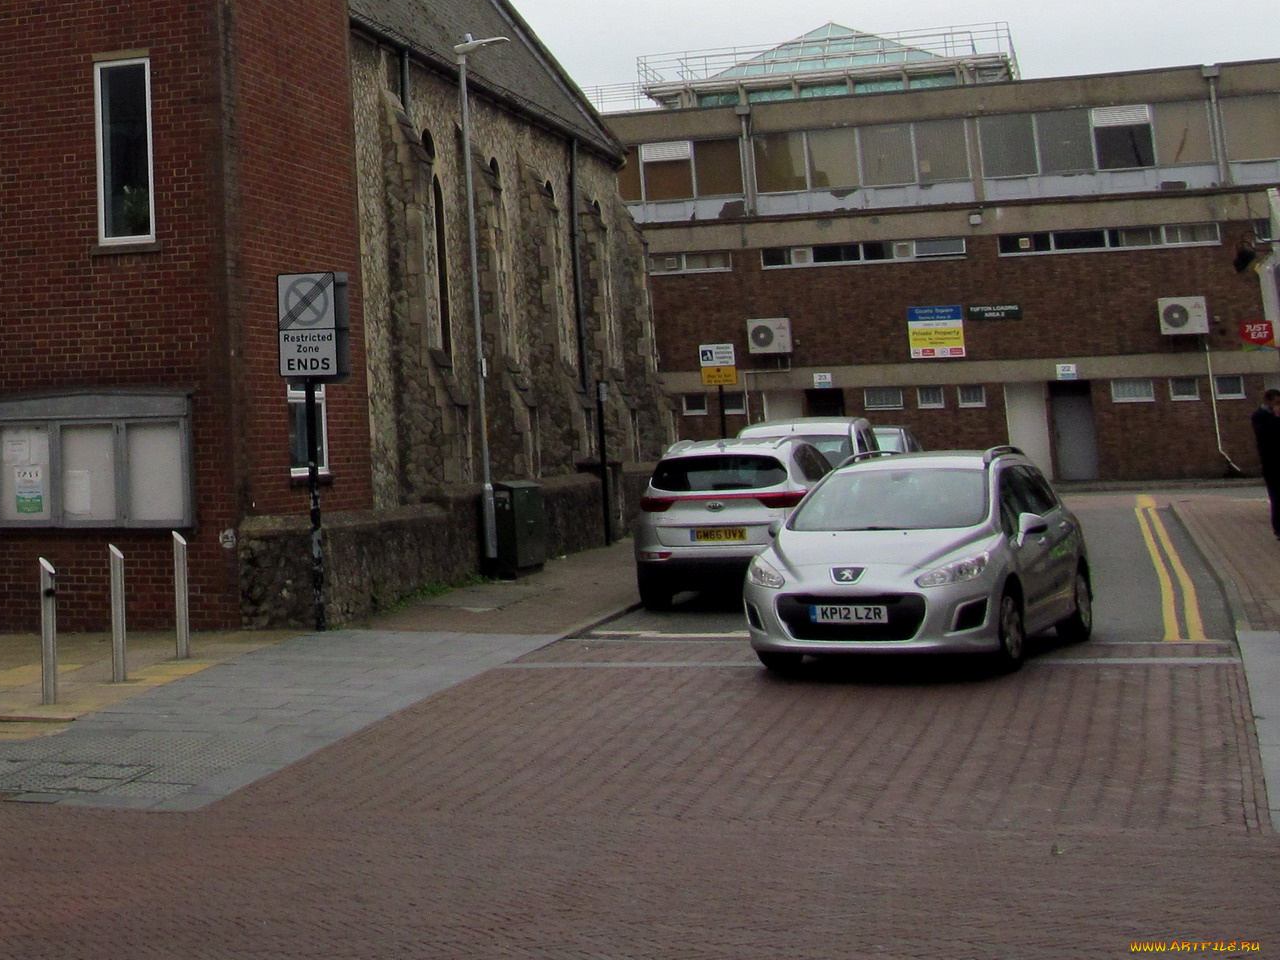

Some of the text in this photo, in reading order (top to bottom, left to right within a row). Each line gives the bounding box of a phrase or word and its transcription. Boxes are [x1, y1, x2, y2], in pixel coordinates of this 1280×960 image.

[1245, 323, 1268, 333] JUST
[283, 333, 332, 342] Restricted
[1251, 331, 1269, 339] EAT
[296, 344, 320, 353] Zone
[287, 357, 330, 370] ENDS
[696, 528, 745, 540] GM66 UVX
[820, 607, 882, 619] KP12 LZR
